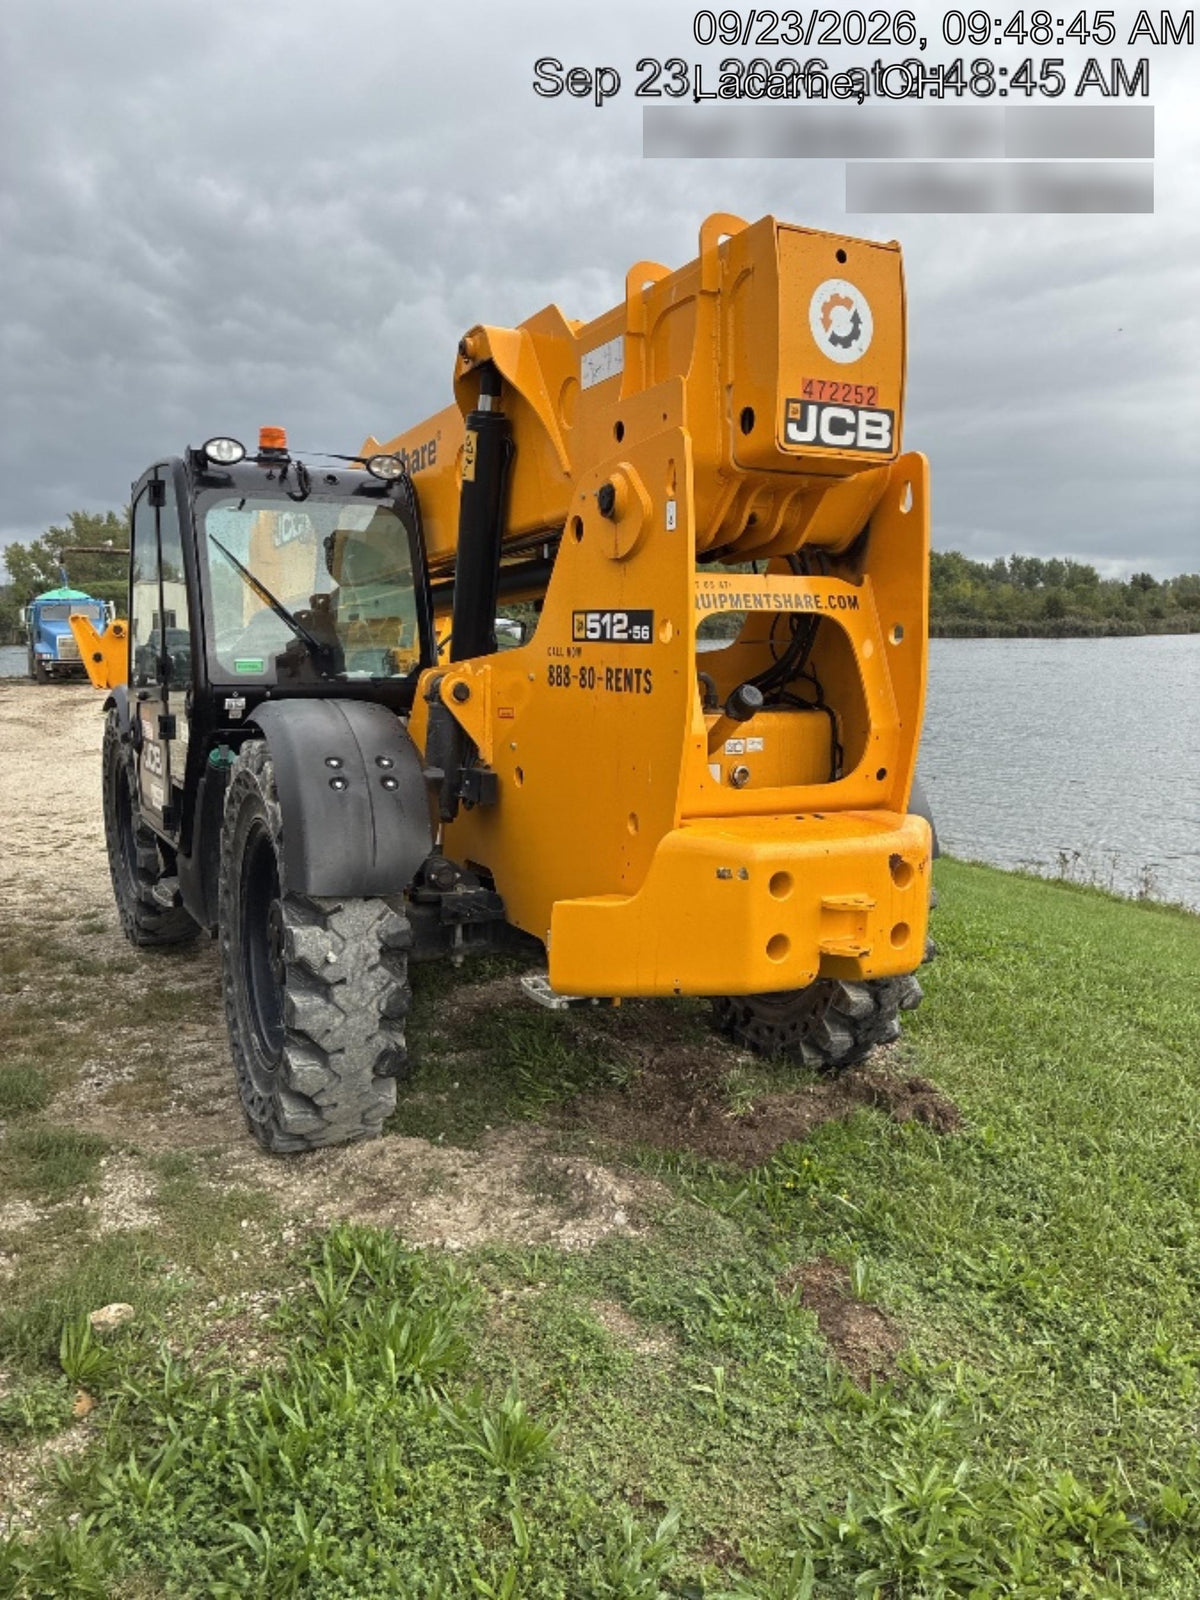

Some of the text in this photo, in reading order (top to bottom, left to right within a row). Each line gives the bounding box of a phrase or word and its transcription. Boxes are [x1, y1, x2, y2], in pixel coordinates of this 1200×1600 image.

[803, 380, 877, 406] 472252
[787, 405, 892, 449] JCB
[548, 664, 652, 694] 888-80-RENTS
